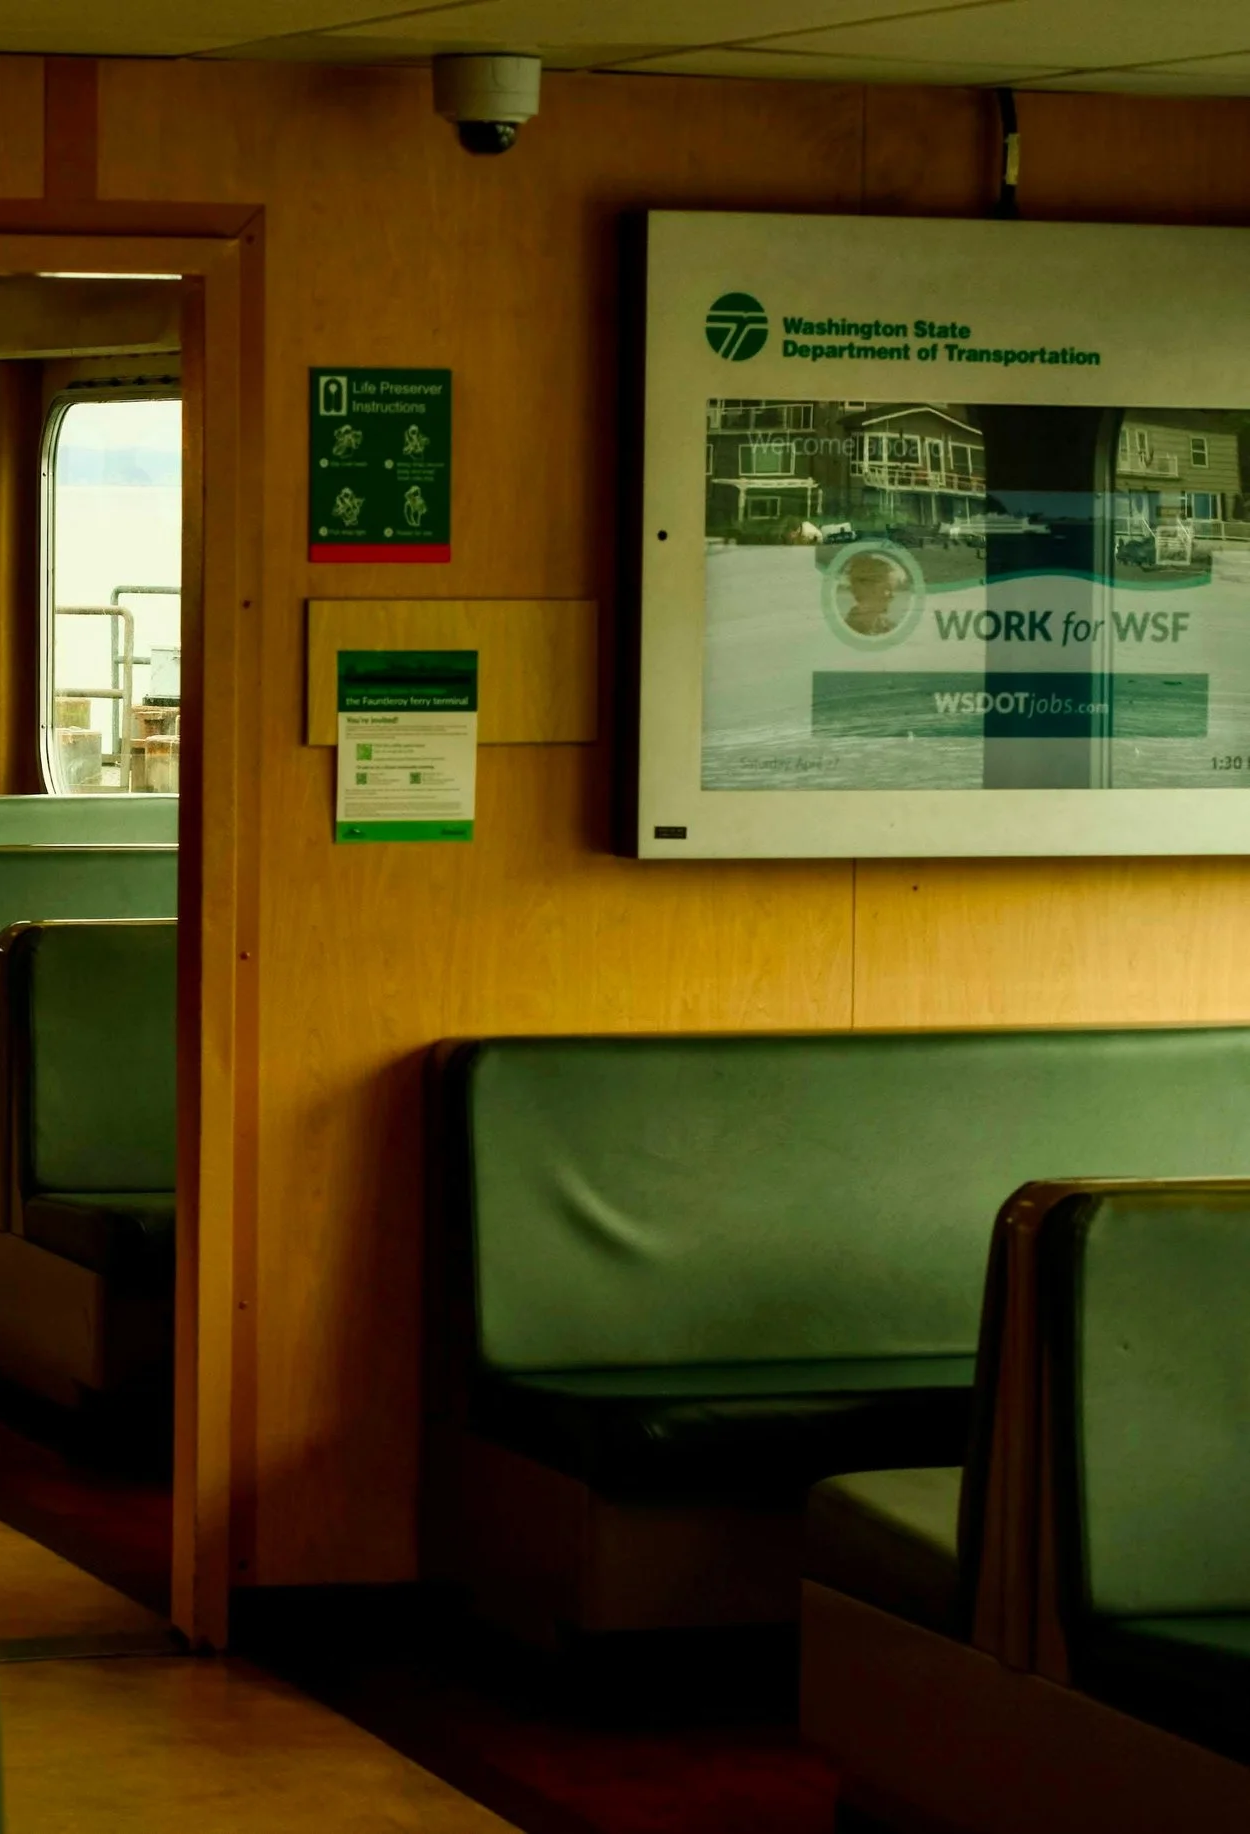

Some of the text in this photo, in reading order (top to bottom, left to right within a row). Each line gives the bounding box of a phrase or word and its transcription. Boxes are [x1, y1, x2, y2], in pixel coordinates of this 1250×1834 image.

[783, 317, 971, 340] Washington State
[783, 340, 1101, 367] Department of Transportation
[352, 381, 443, 395] Life Preserver
[352, 400, 427, 414] Instructions
[748, 432, 856, 456] Welcome
[934, 610, 1191, 648] WORK for WSF
[345, 696, 361, 706] the
[362, 695, 408, 707] Fauntleroy
[432, 696, 469, 707] terminal
[934, 692, 1110, 719] WSDOTjobs.com
[1211, 755, 1243, 770] 1:30
